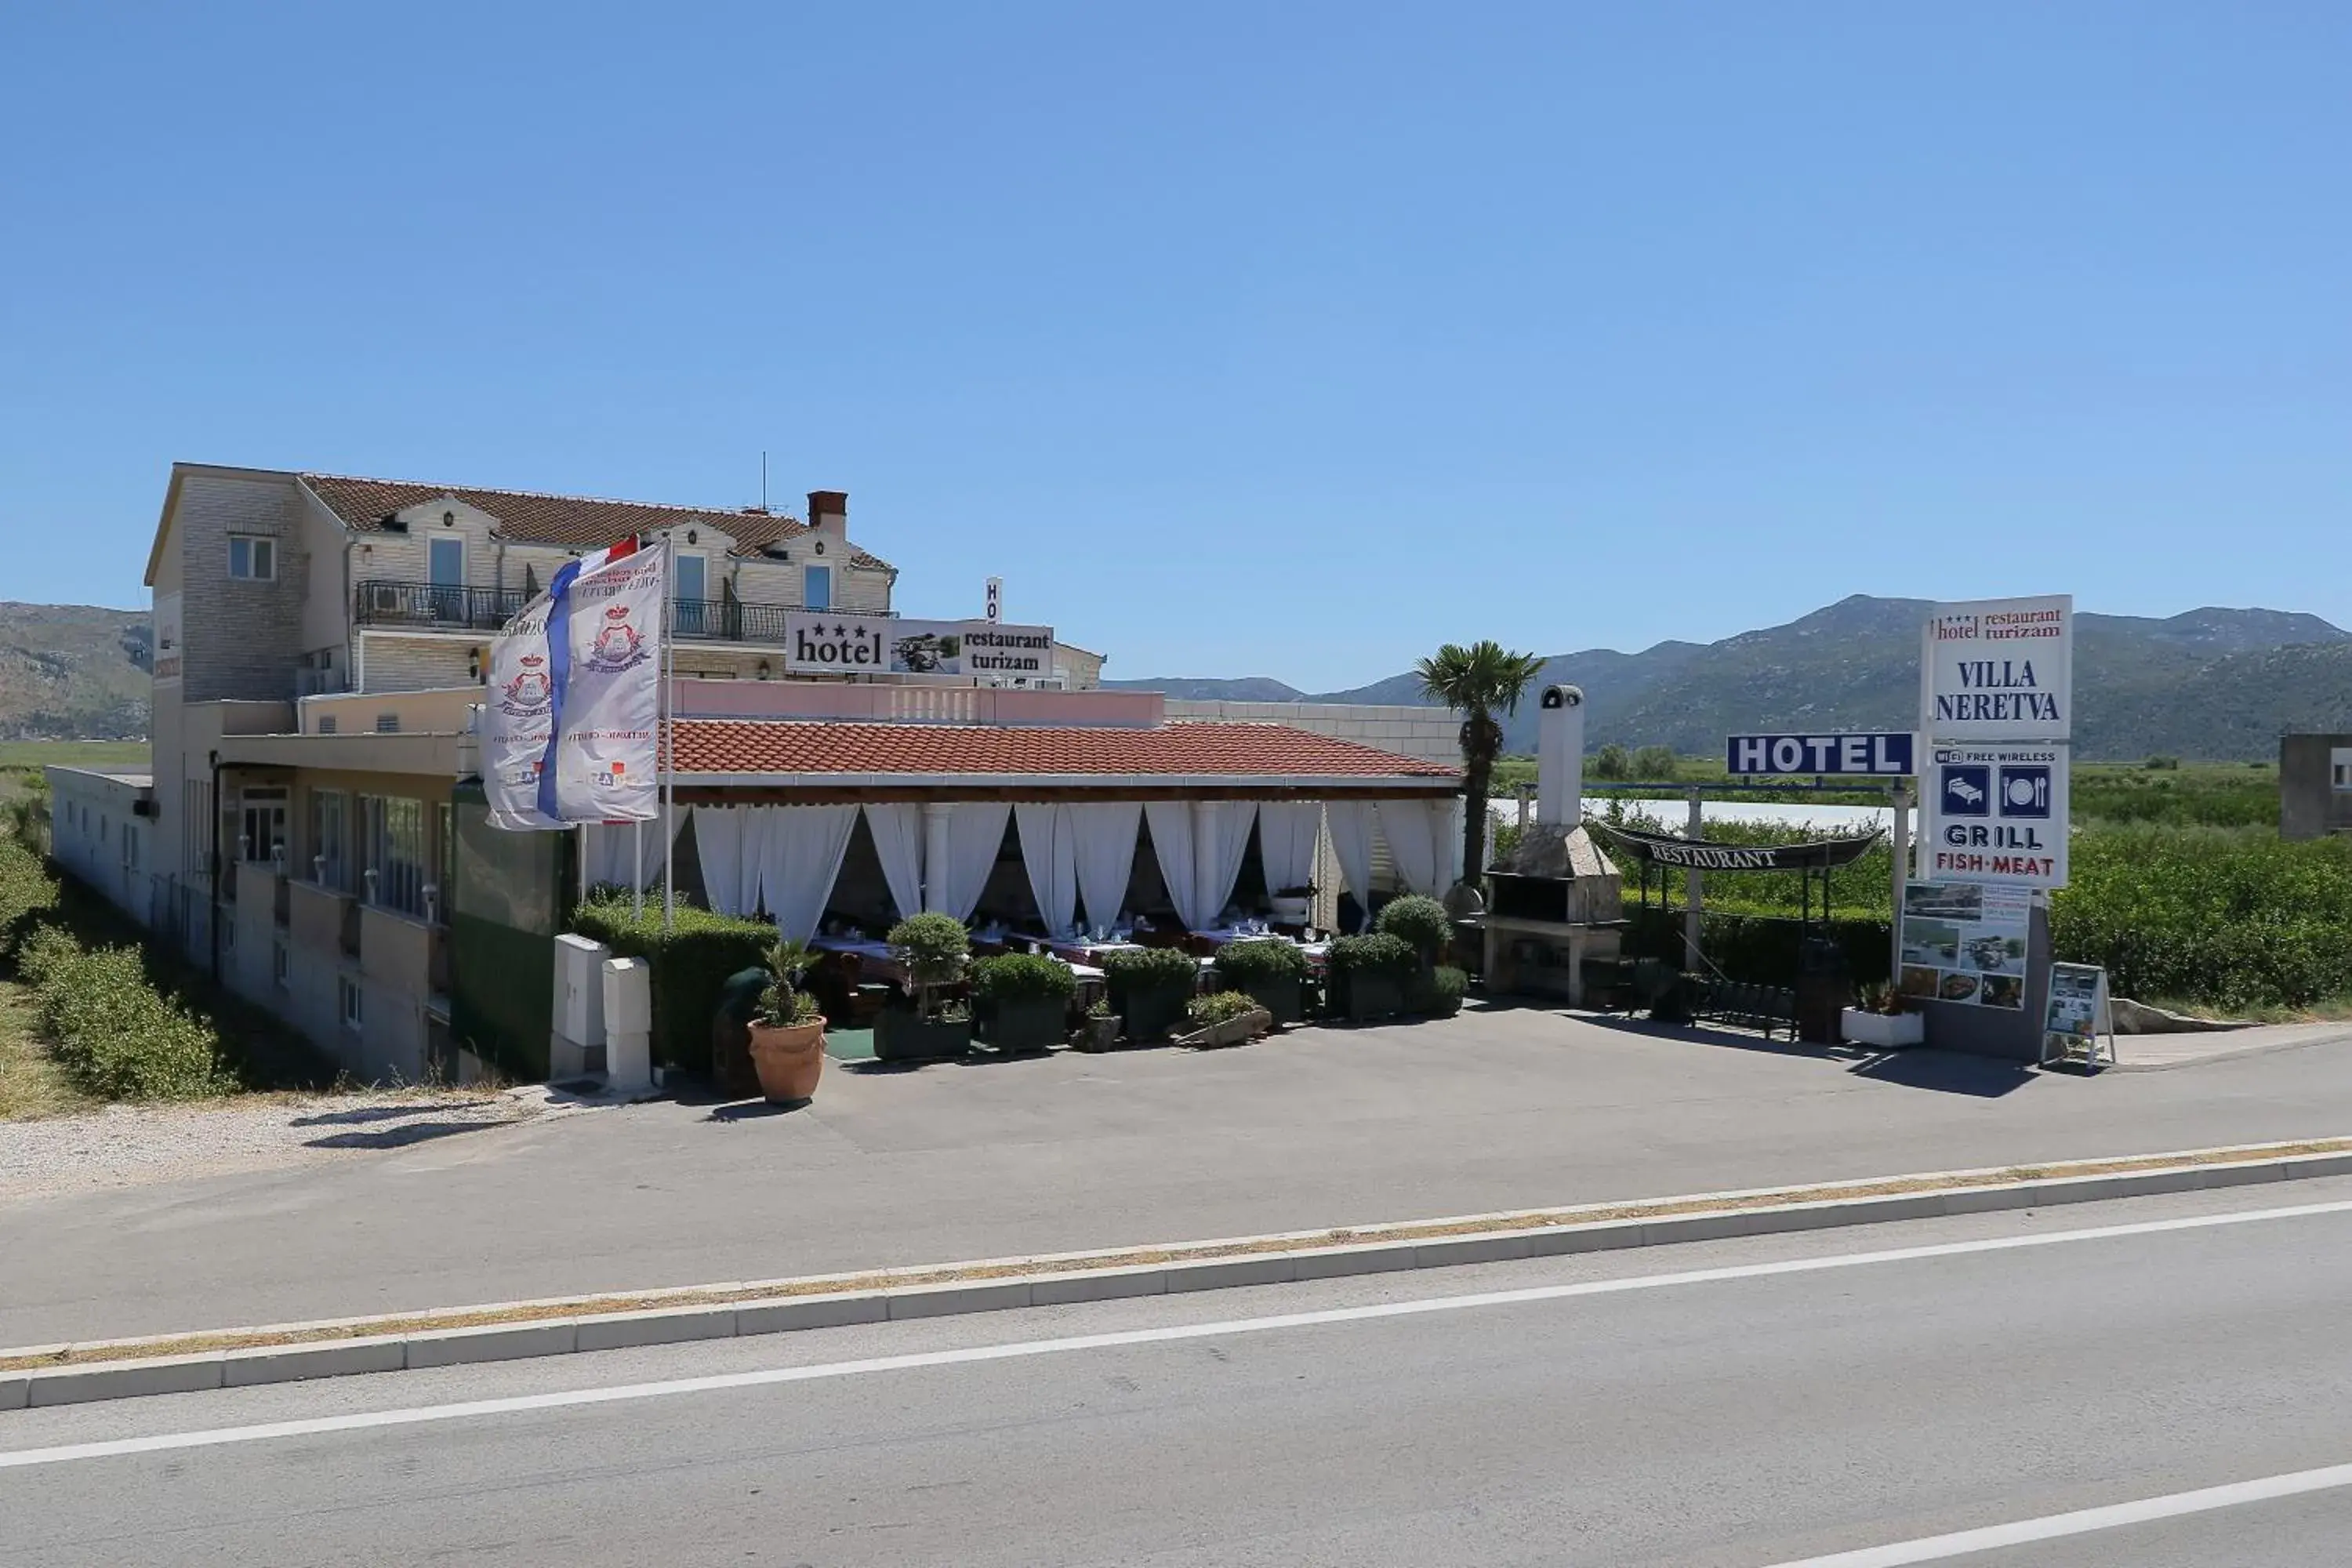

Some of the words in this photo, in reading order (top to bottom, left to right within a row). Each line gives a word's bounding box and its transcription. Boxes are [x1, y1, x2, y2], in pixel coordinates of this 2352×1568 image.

[987, 584, 996, 624] HO
[1938, 615, 1979, 640] hotel
[1985, 609, 2062, 626] restaurant
[796, 629, 881, 665] hotel
[965, 630, 1050, 650] restaurant
[971, 652, 1039, 671] turizam
[1958, 660, 2038, 688] VILLA
[1936, 692, 2060, 720] NERETVA
[1738, 737, 1901, 772] HOTEL
[1966, 752, 1994, 761] FREE
[1998, 752, 2056, 761] WIRELESS
[1944, 824, 2043, 850] GRILL
[1650, 844, 1776, 868] RESTAURANT
